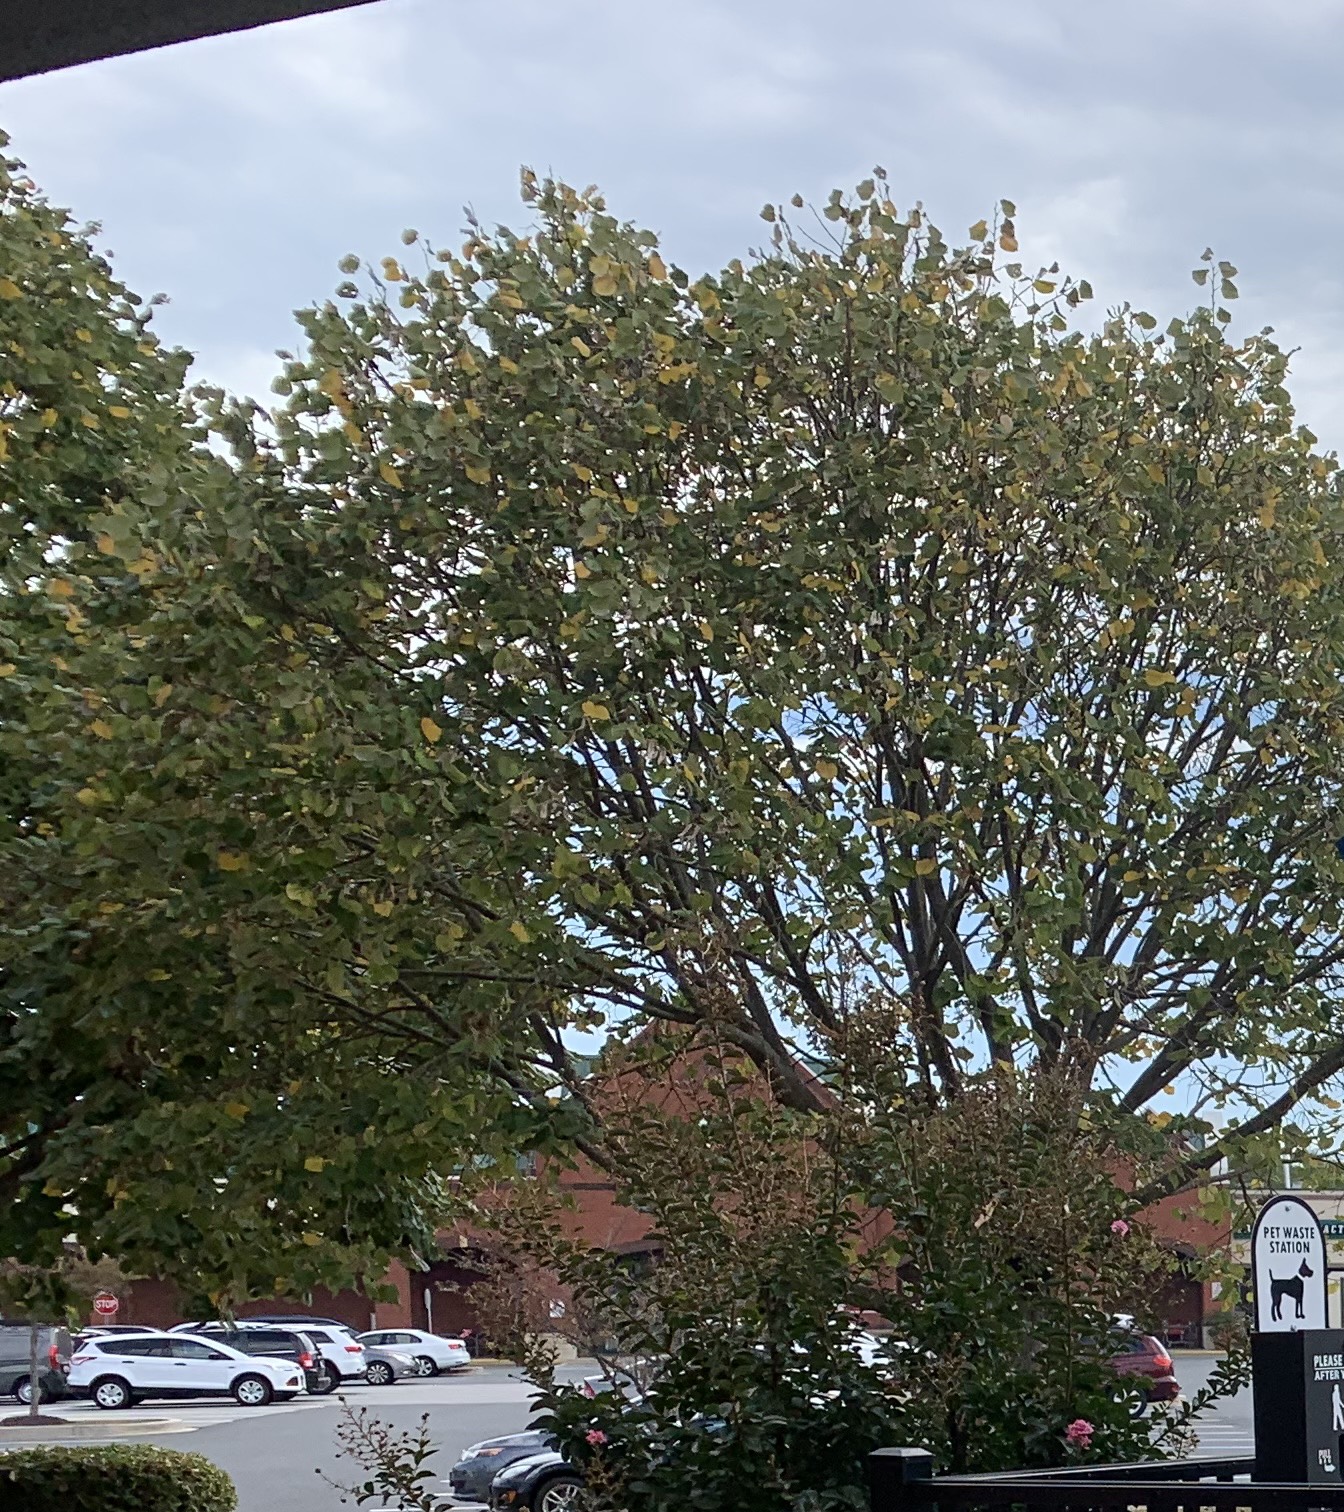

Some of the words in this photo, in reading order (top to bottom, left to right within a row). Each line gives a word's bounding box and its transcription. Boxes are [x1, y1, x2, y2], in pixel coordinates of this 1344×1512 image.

[1263, 1226, 1281, 1239] PET
[1282, 1226, 1315, 1239] WASTE
[1269, 1240, 1310, 1253] STATION
[1314, 1354, 1343, 1367] PLEASE
[1314, 1370, 1340, 1381] AFTER
